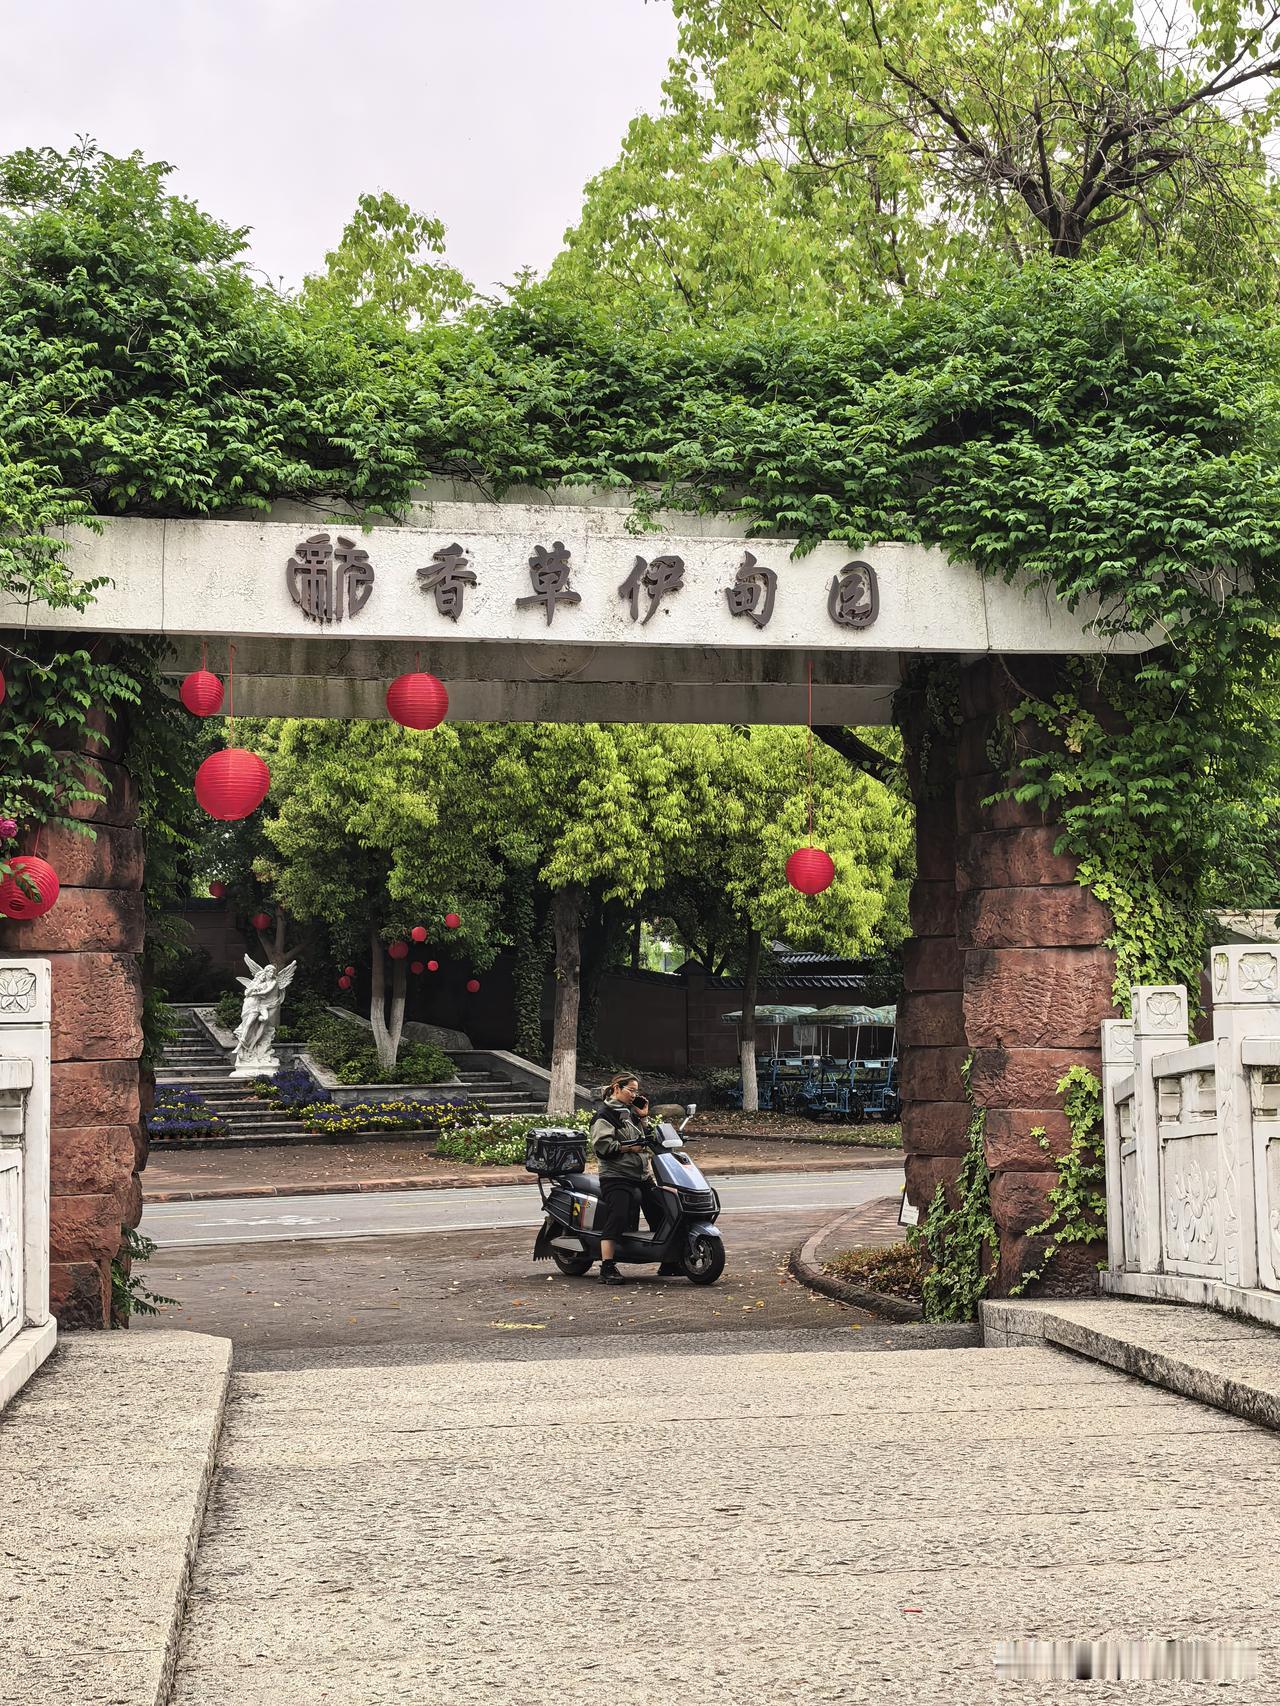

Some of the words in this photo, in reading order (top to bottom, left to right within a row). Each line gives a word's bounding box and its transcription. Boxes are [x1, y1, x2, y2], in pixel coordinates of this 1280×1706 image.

[416, 541, 880, 629] 香草伊甸园
